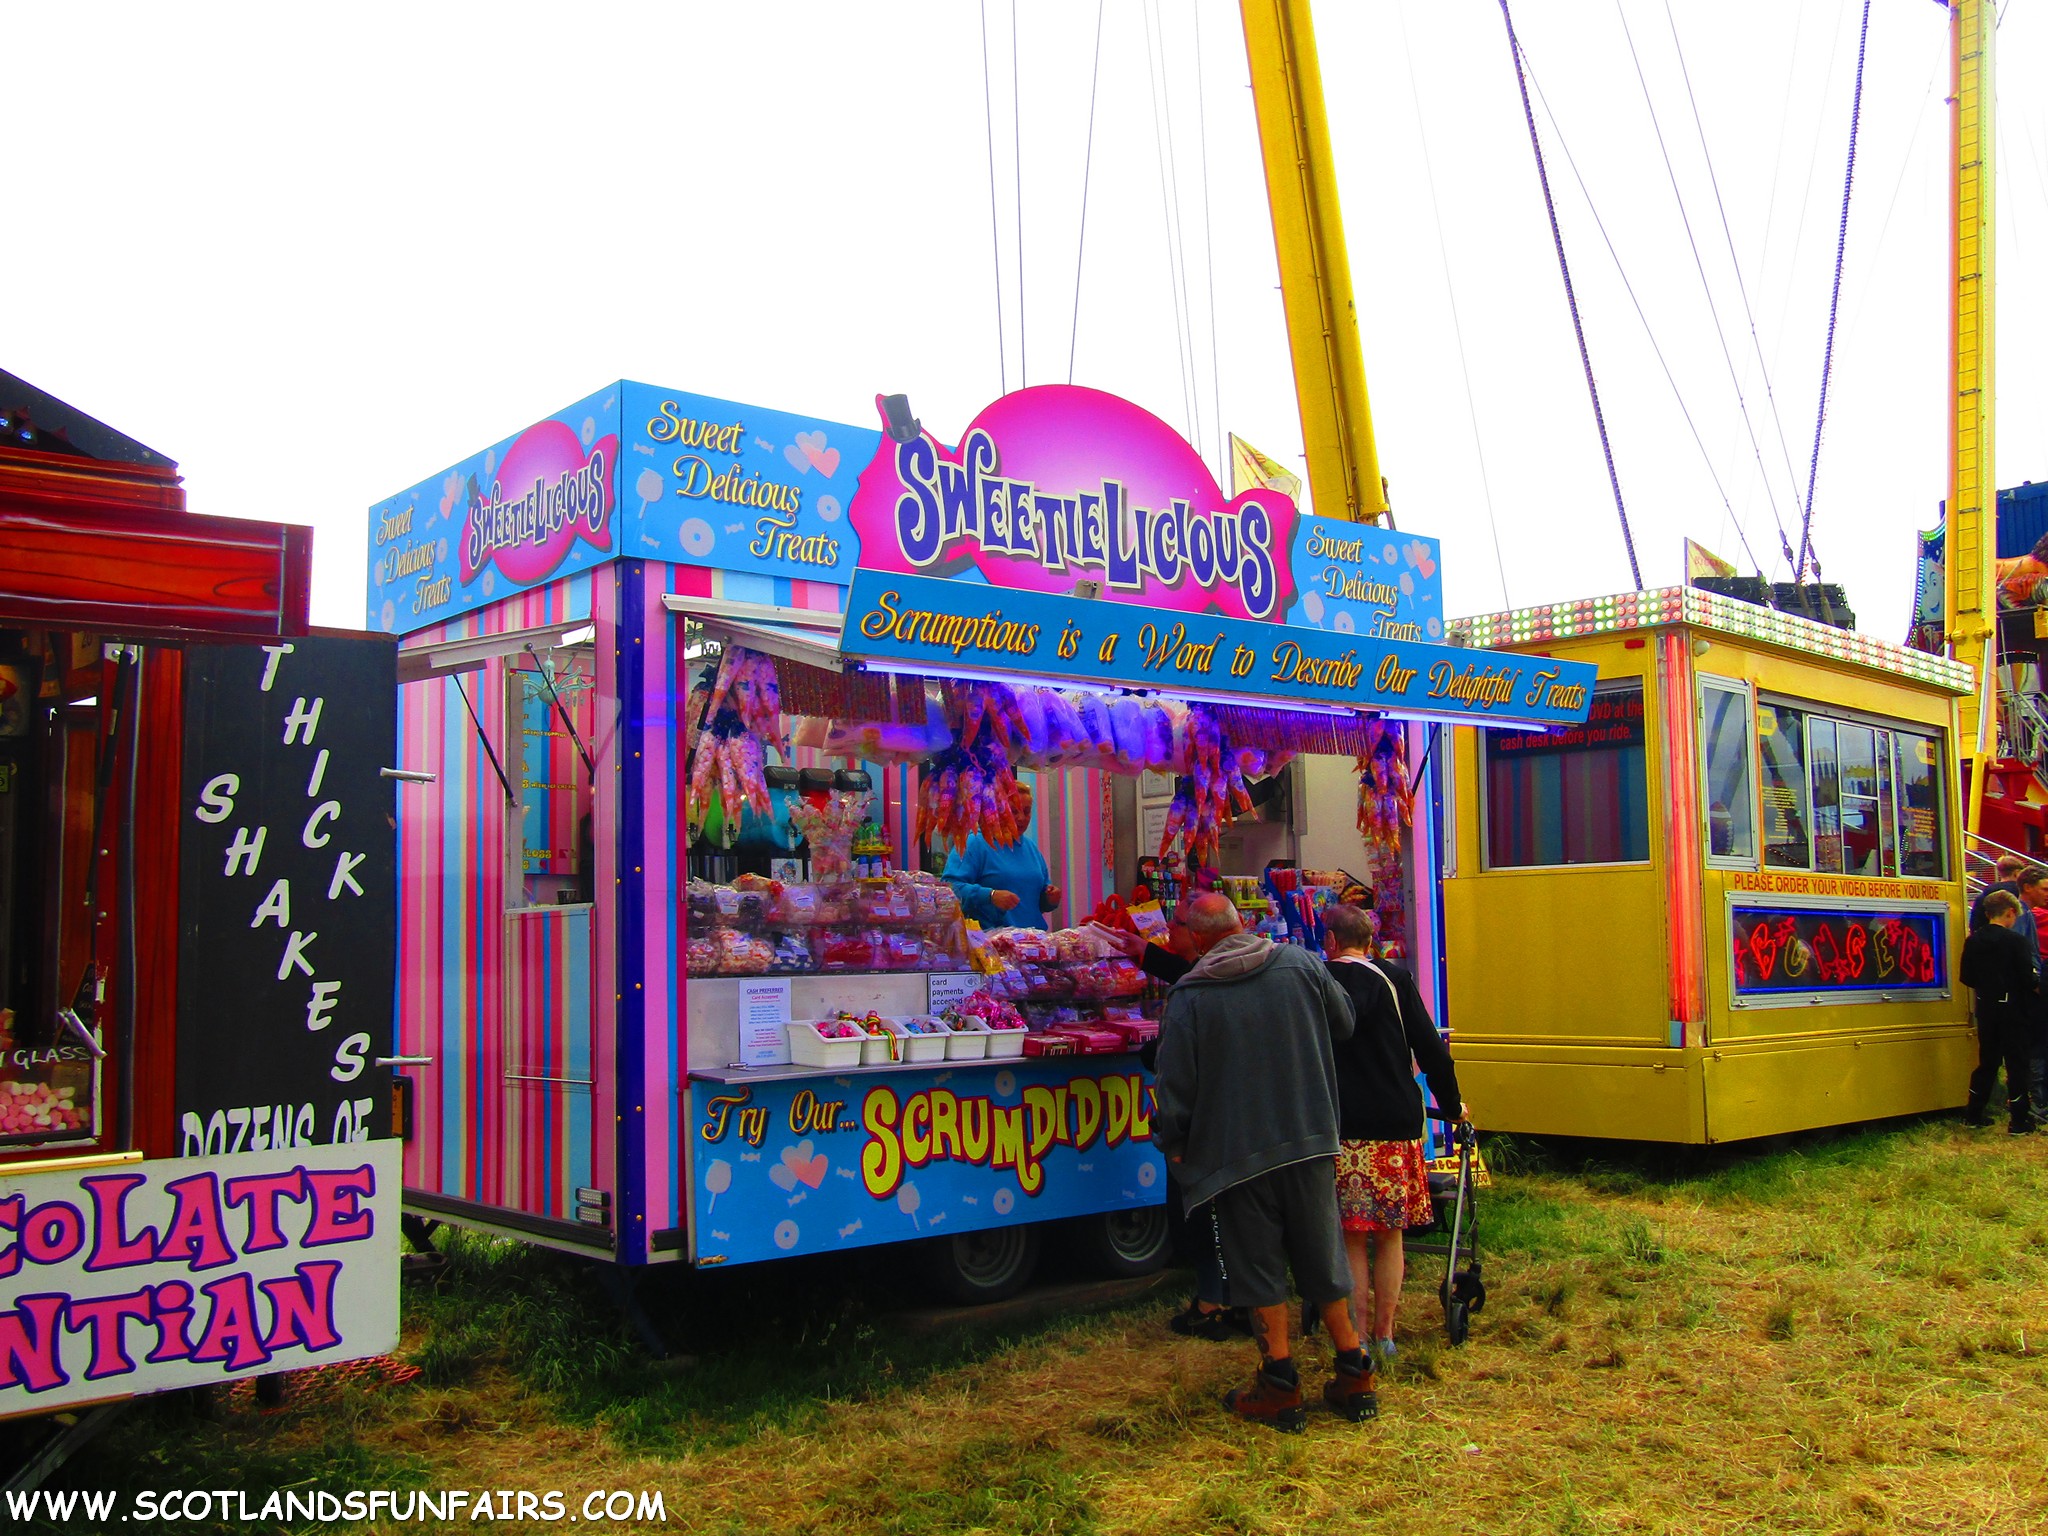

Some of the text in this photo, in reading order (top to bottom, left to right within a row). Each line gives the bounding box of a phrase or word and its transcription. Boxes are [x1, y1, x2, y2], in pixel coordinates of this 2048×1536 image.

[647, 400, 745, 455] Sweet
[672, 454, 802, 514] Delicious
[376, 504, 414, 546] Sweet
[468, 450, 604, 570] SWEETIELICIOUS
[895, 427, 1276, 618] SWEETIELICIOUS
[749, 512, 839, 567] Treats
[1305, 524, 1364, 563] Sweet
[385, 540, 437, 584] Delicious
[413, 573, 452, 615] Treats
[1322, 565, 1400, 607] Delicious
[1369, 606, 1423, 641] Treats
[859, 590, 1587, 712] Scrumptious is a Word to Describe Our Delightful Treats
[1614, 704, 1625, 718] at
[1627, 700, 1643, 717] the
[1500, 734, 1523, 750] cash
[1525, 732, 1549, 748] desk
[1587, 728, 1606, 747] you
[261, 643, 367, 900] THICK
[1734, 874, 1940, 900] PLEASE ORDER YOUR VIDEO BEFORE YOU RIDE
[195, 773, 371, 1083] SHAKES
[931, 988, 964, 997] payments
[13, 1046, 91, 1070] GLASS
[701, 1085, 769, 1147] Try
[861, 1073, 1157, 1198] SCRUMDIDDL
